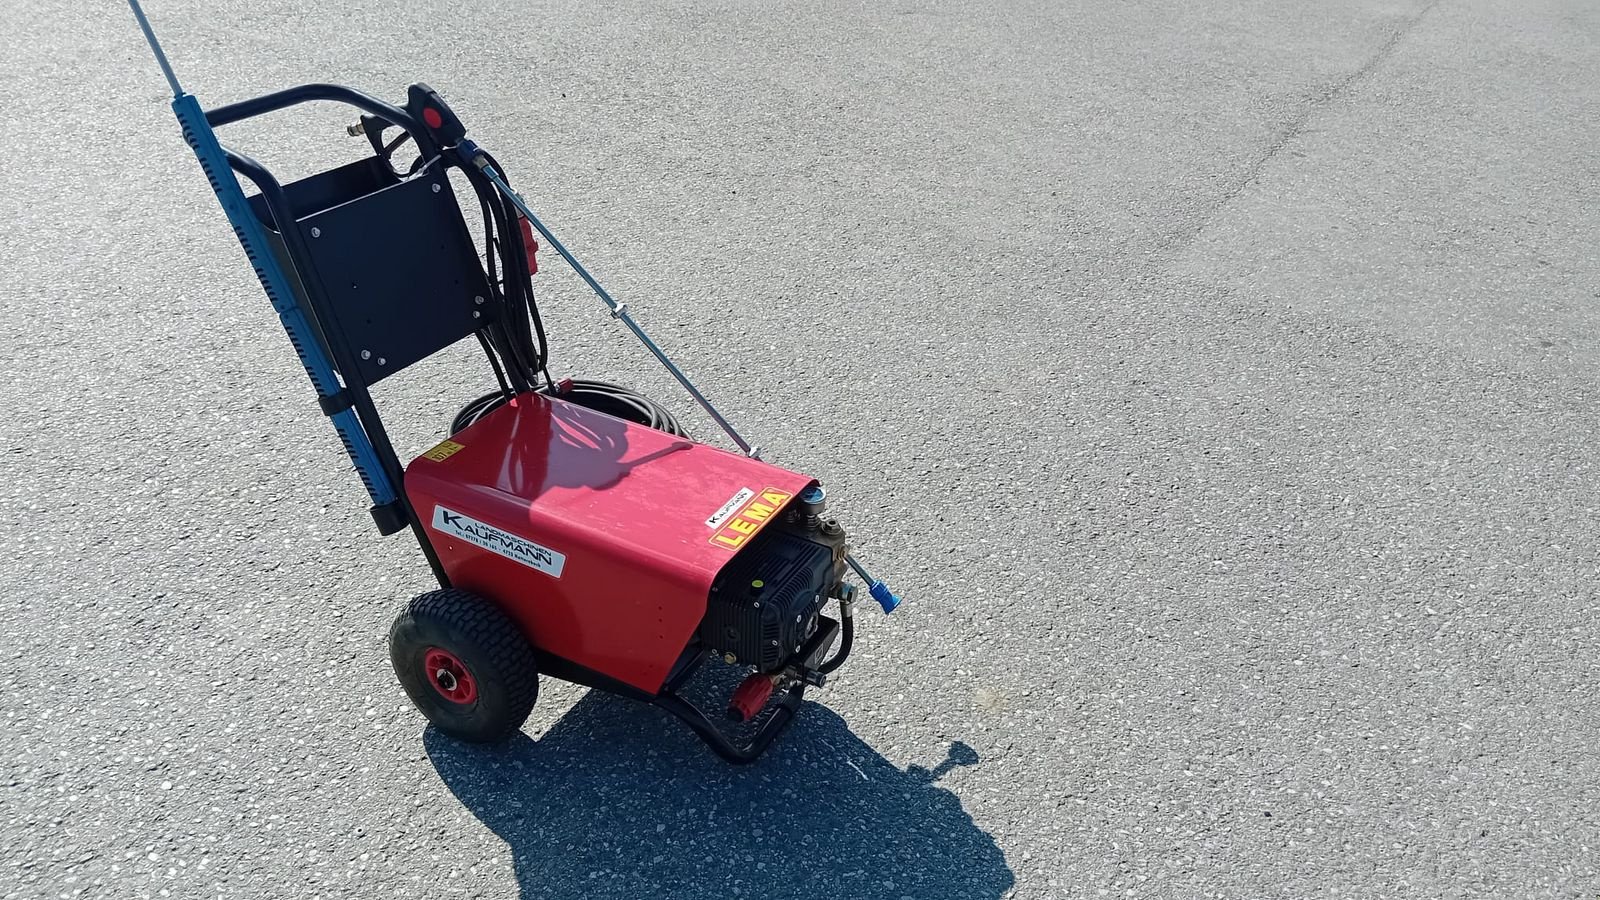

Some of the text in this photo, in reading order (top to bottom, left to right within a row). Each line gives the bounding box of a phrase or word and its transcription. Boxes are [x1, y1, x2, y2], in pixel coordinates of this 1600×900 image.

[442, 510, 552, 566] KAUFMANN
[474, 522, 552, 557] LANDMASCHINEN
[715, 492, 790, 547] LEMA
